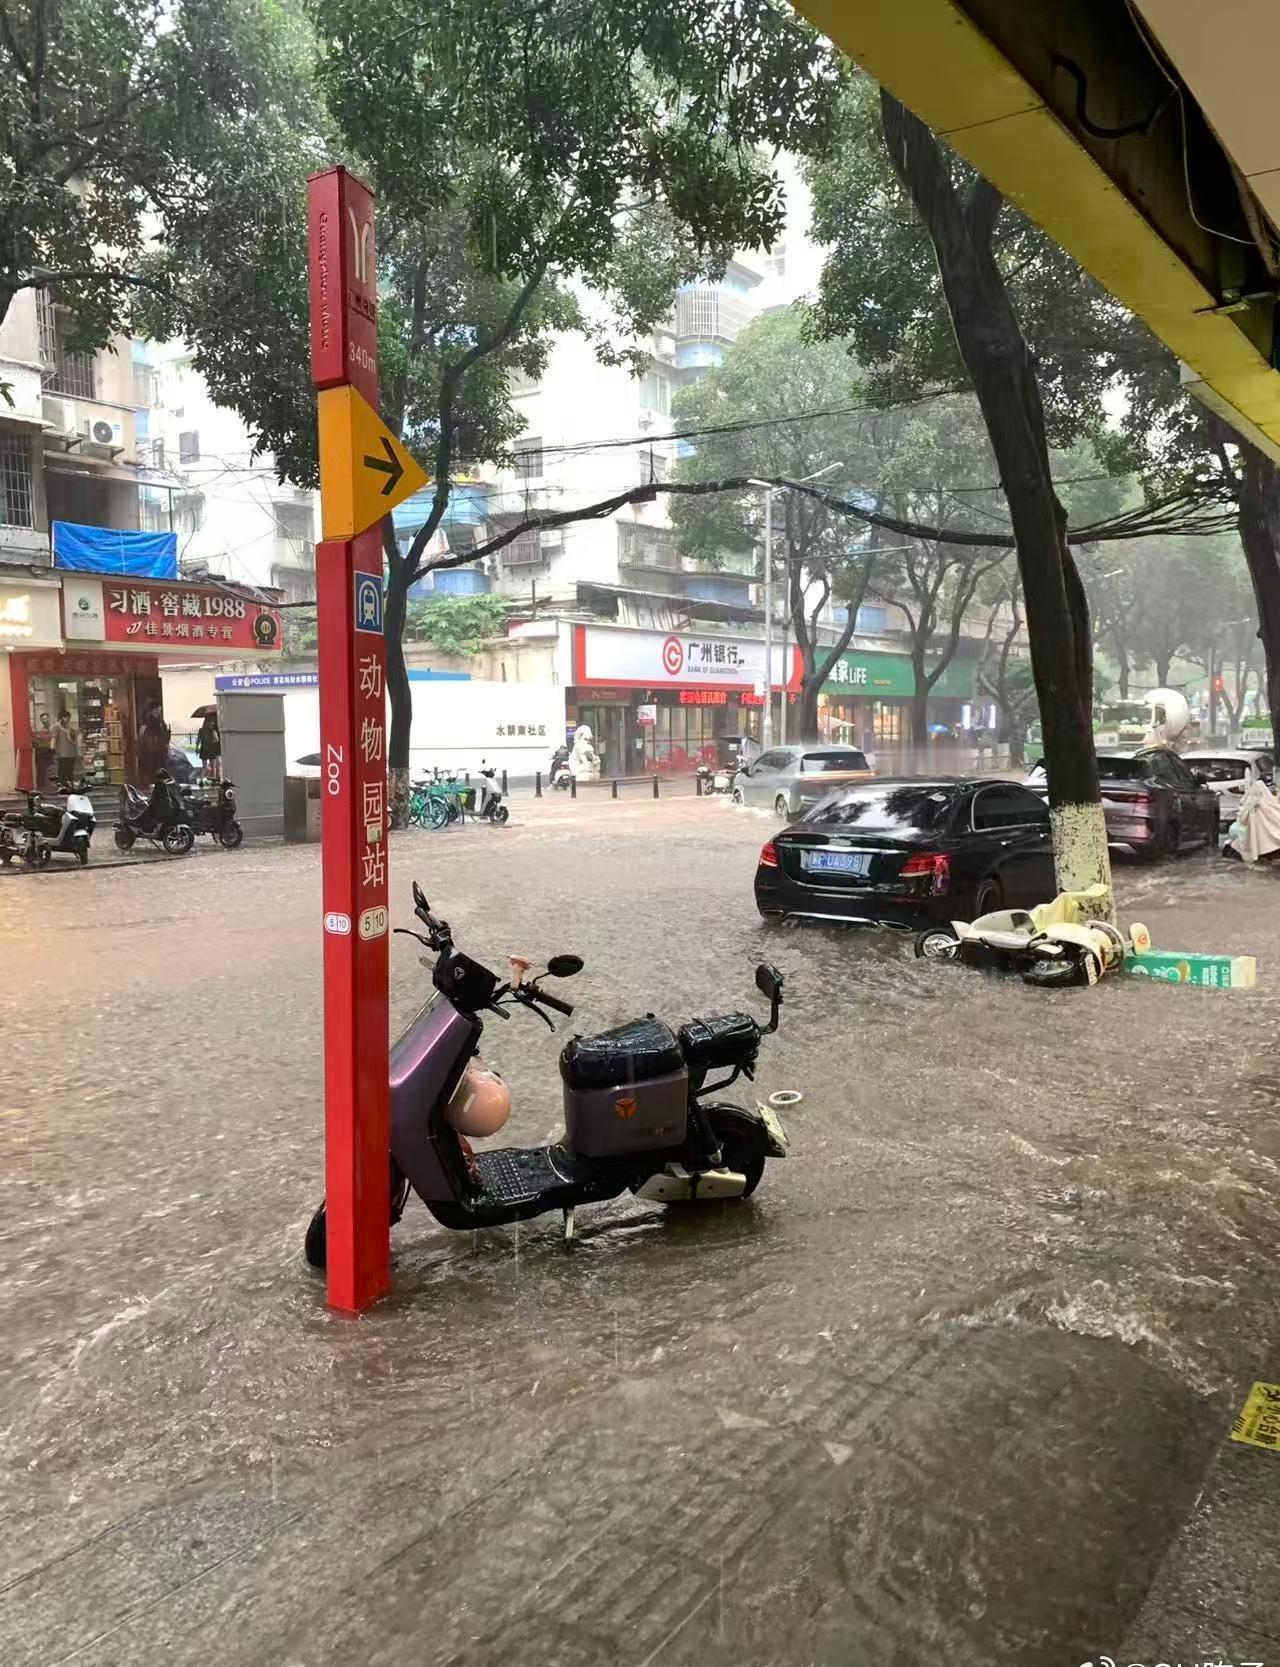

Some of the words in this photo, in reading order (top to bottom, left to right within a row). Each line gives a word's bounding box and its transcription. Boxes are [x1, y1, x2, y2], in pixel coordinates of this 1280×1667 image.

[320, 212, 329, 300] Guangzhou
[320, 304, 329, 350] Metro
[350, 342, 376, 374] 340m
[145, 621, 234, 641] 佳景烟酒专营
[688, 642, 738, 664] 广州银行
[250, 677, 271, 685] POLICE
[359, 654, 384, 888] 动物园站
[329, 917, 336, 928] 5
[338, 918, 347, 929] 10
[364, 917, 371, 932] 5
[375, 911, 385, 928] 10
